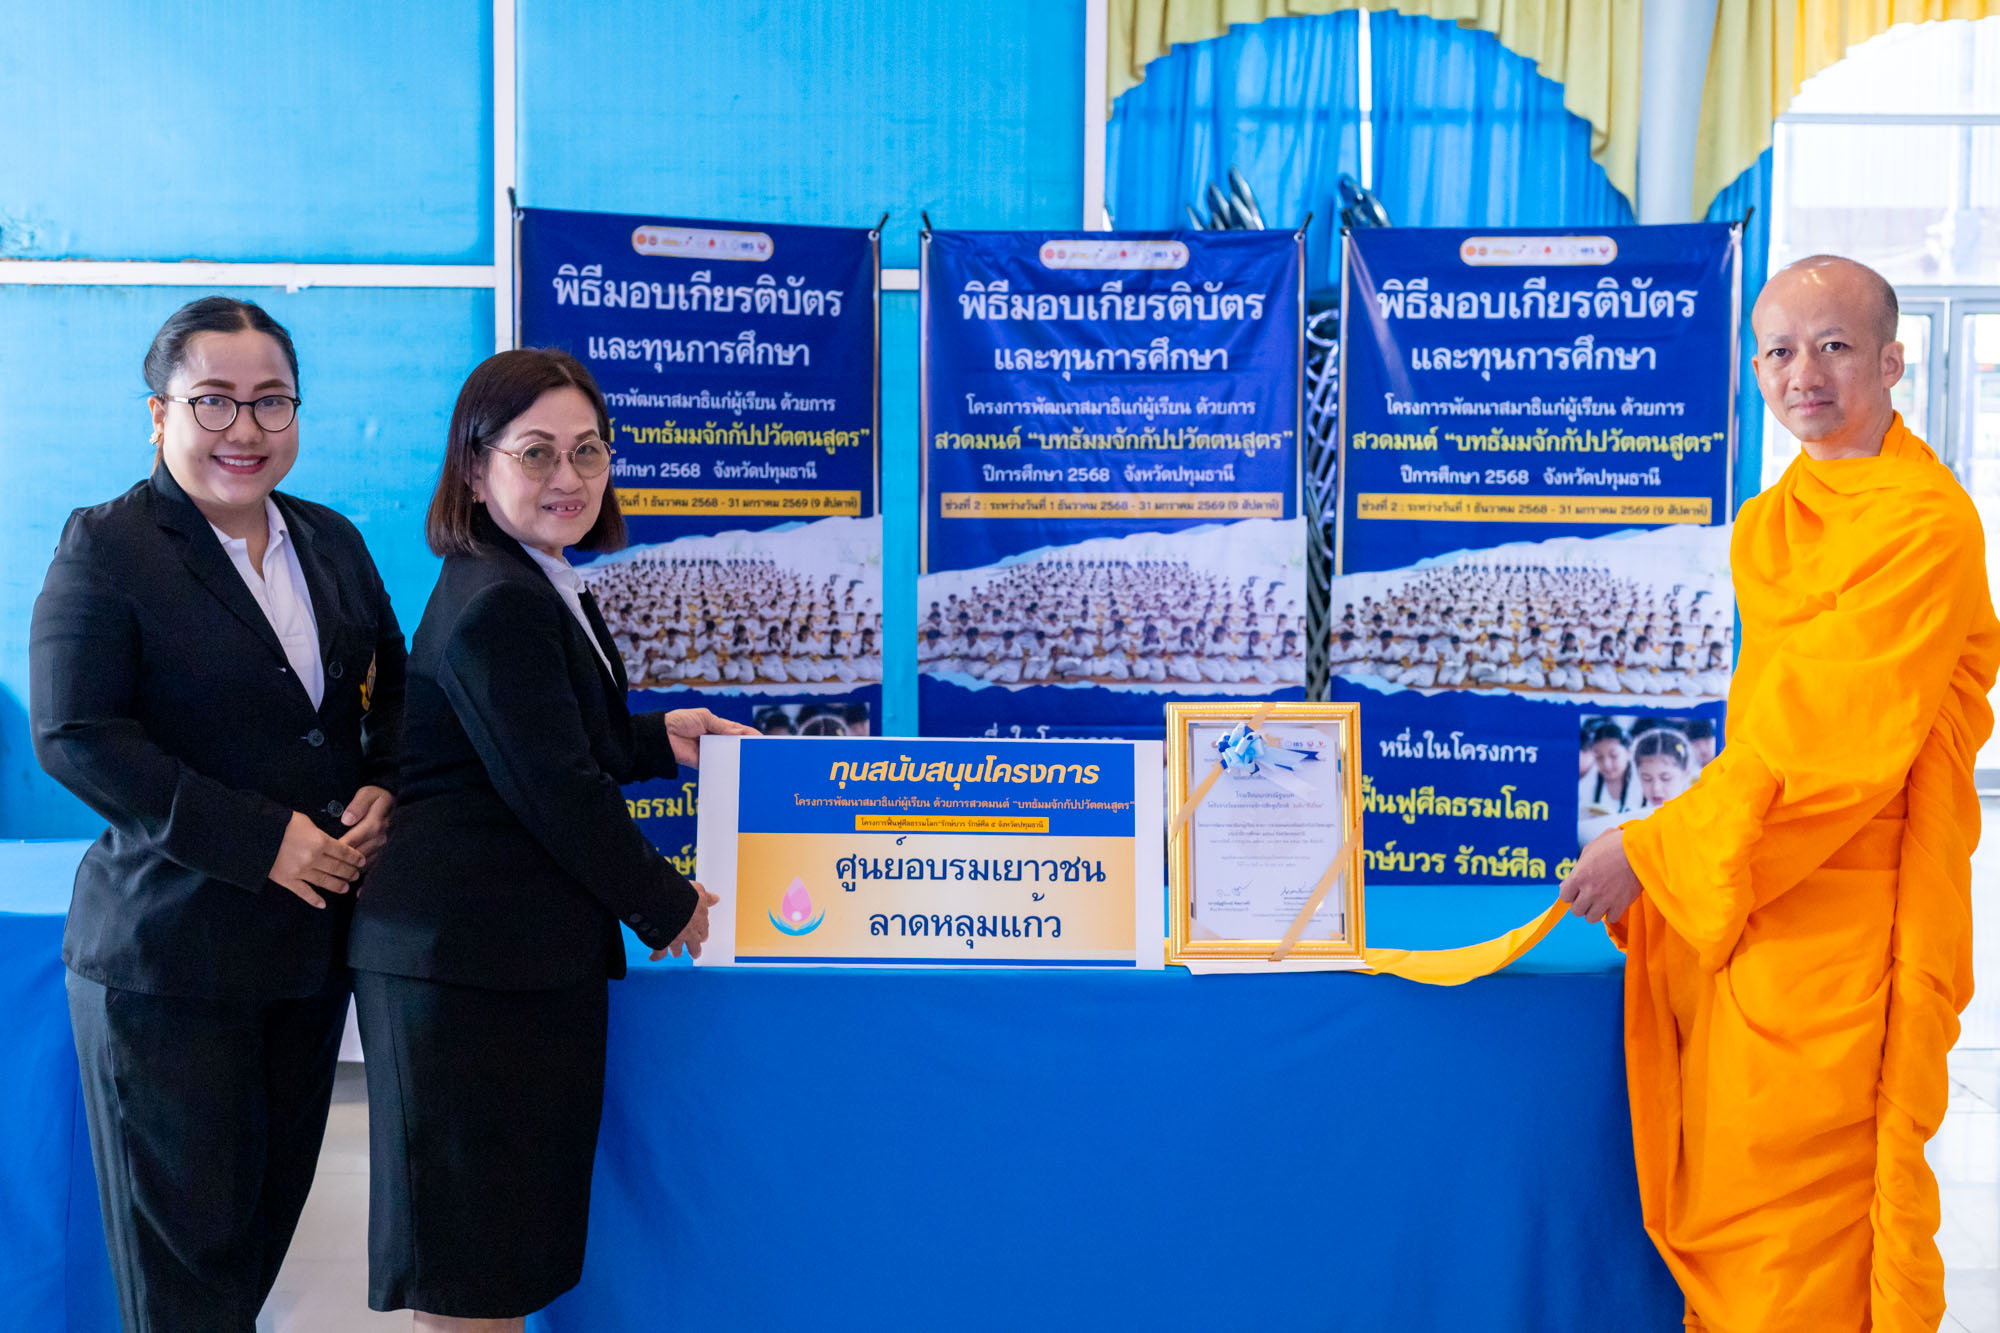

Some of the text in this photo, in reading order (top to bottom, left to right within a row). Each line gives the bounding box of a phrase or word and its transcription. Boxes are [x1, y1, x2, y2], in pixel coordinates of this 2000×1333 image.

[552, 263, 843, 317] พิธีมอบเกียรติบัตร
[958, 279, 1266, 322] พิธีมอบเกียรติบัตร
[1376, 275, 1698, 319] พิธีมอบเกียรติบัตร
[588, 330, 810, 372] และทุนการศึกษา
[994, 336, 1229, 381] และทุนการศึกษา
[1411, 333, 1656, 381] และทุนการศึกษา
[780, 391, 836, 411] ด้วยการ
[966, 393, 1256, 421] โครงการพัฒนาสมาธิแก่ผู้เรียน ด้วยการ
[1385, 392, 1685, 422] โครงการพัฒนาสมาธิแก่ผู้เรียน ด้วยการ
[935, 425, 1022, 450] สวดมนต์
[1352, 425, 1439, 451] สวดมนต์
[660, 463, 701, 478] 2568
[713, 460, 817, 484] จังหวัดปทุมธานี
[982, 463, 1235, 487] ปีการศึกษา 2568 จังหวัดปทุมธานี
[1400, 464, 1661, 491] ปีการศึกษา 2568 จังหวัดปทุมธานี
[691, 498, 718, 508] 2568
[728, 498, 739, 508] 31
[1139, 501, 1151, 511] 31
[1559, 505, 1572, 514] 31
[1379, 727, 1538, 763] หนึ่งในโครงการ
[829, 755, 1100, 791] ทุนสนับสนุนโครงการ
[794, 793, 930, 811] โครงการพัฒนาสมาธิแก่ผู้เรียน
[933, 796, 1010, 808] ด้วยการสวดมนต์
[835, 836, 1106, 892] ศูนย์อบรมเยาวชน
[1454, 845, 1546, 879] รักษ์ศีล
[868, 892, 1062, 949] ลาดหลุมแก้ว
